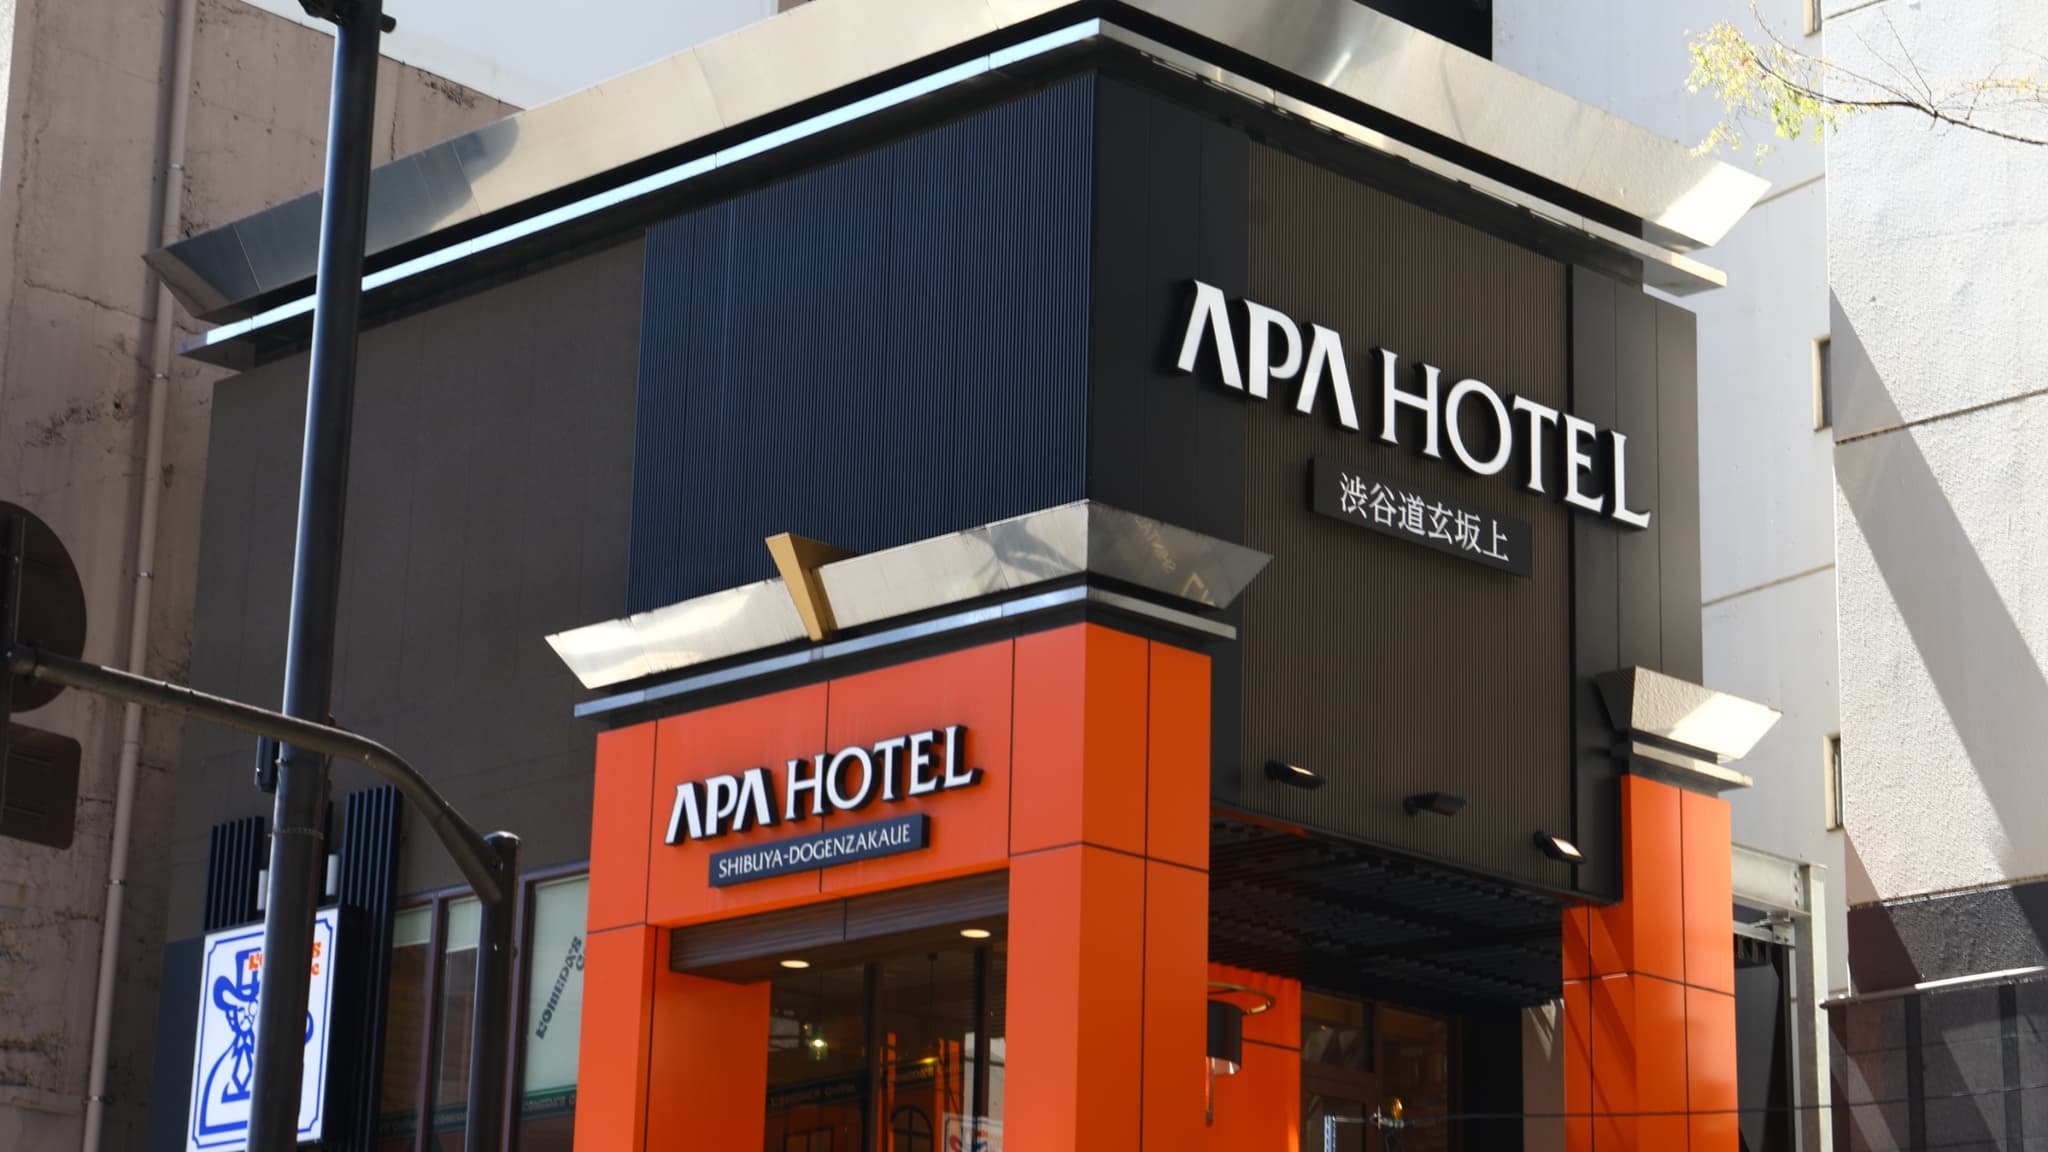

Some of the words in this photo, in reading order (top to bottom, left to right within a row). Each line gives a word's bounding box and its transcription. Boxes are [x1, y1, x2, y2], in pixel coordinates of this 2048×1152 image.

[1177, 279, 1360, 432] APA
[1379, 348, 1652, 529] HOTEL
[1339, 471, 1510, 563] 渋谷道玄坂上
[664, 767, 773, 845] APA
[784, 725, 975, 821] HOTEL
[717, 823, 912, 879] SHIBUYA-DOGENZAKAUE
